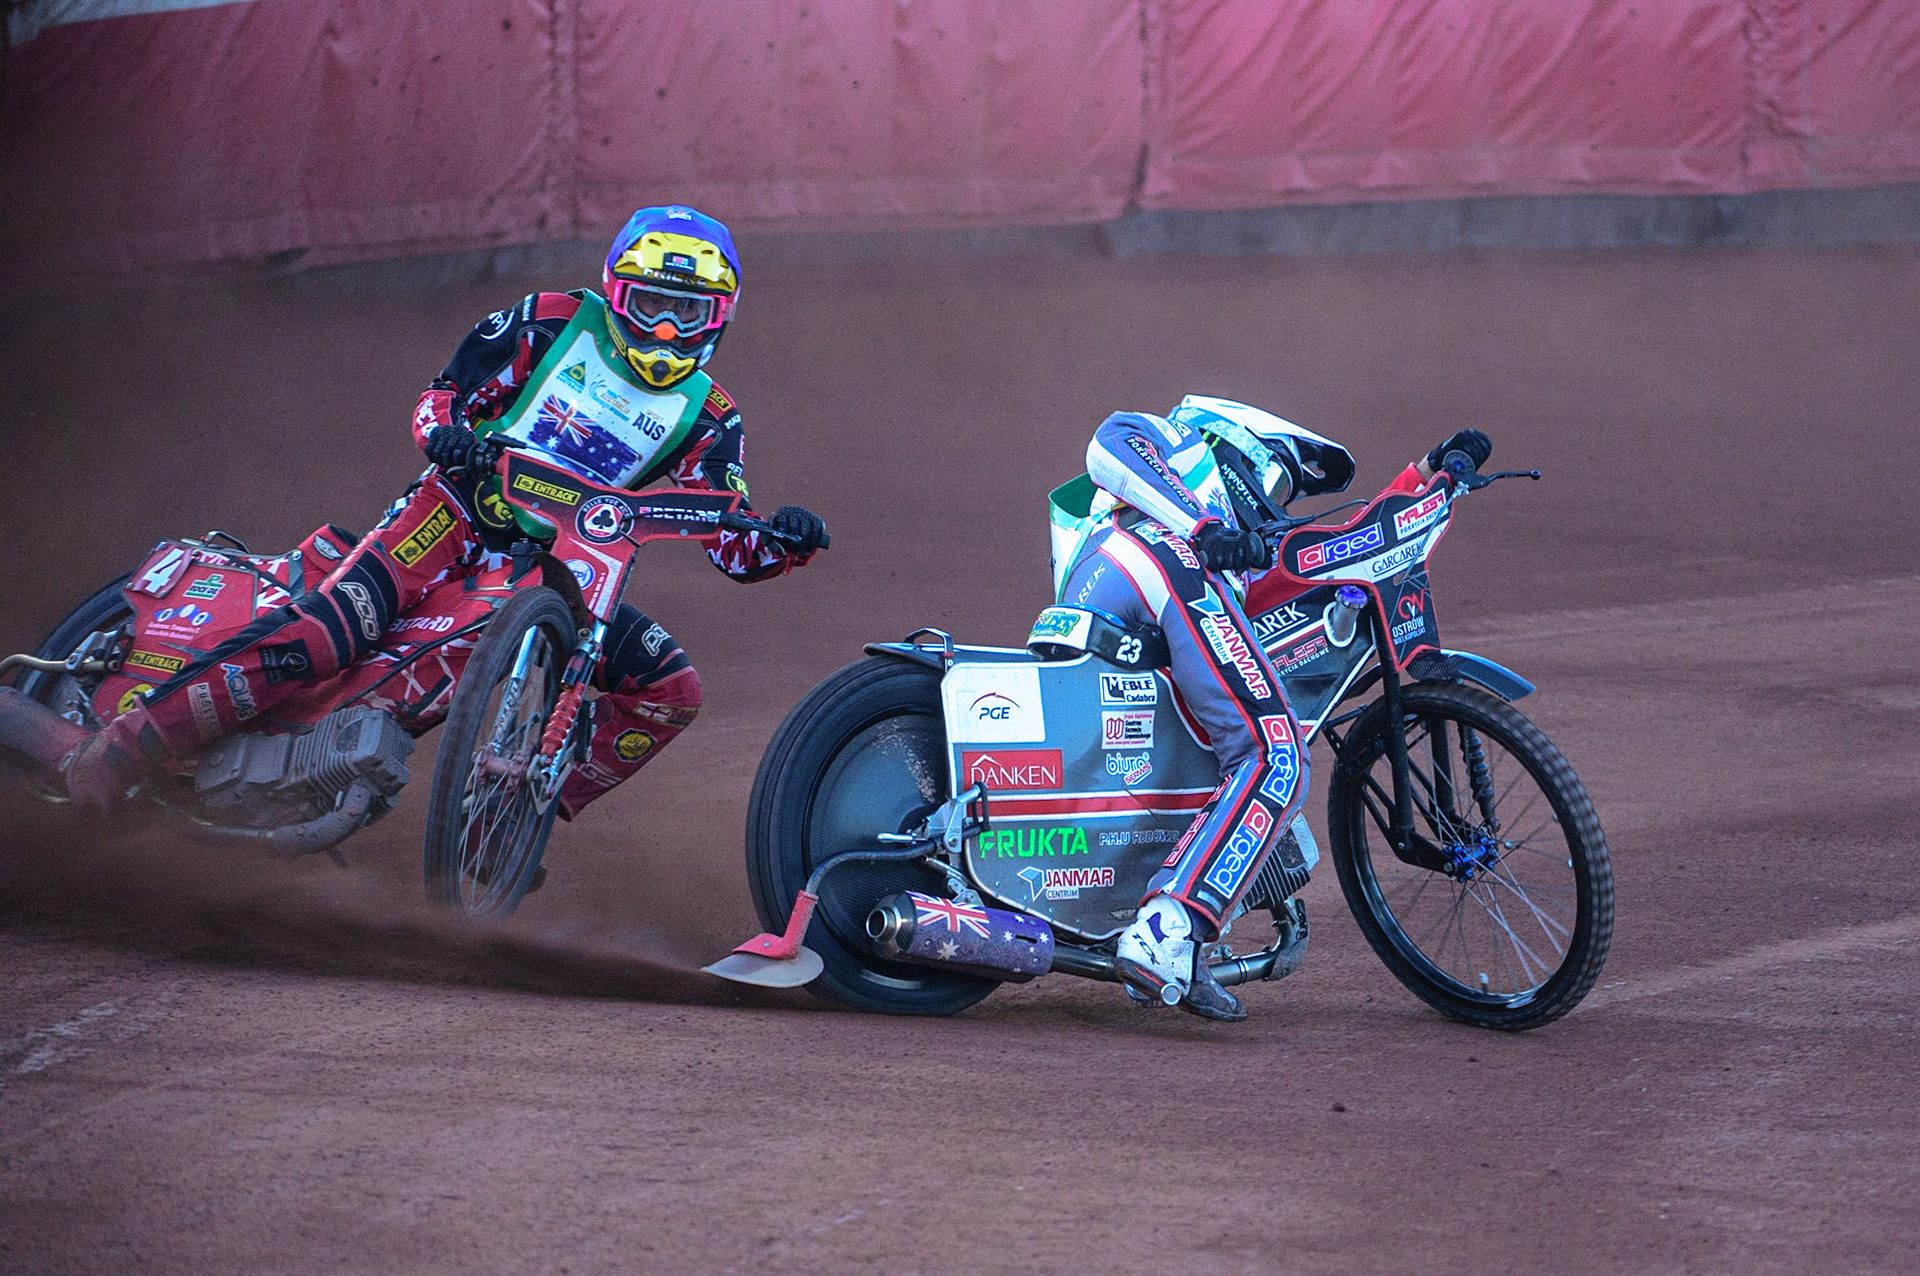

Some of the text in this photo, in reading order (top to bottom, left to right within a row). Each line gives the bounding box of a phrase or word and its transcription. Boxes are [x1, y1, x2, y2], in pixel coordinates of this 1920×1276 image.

[707, 391, 726, 408] ACK
[632, 411, 665, 440] AUS
[1127, 438, 1163, 474] POKRYCIA
[1163, 475, 1199, 511] DACHOW
[533, 483, 575, 502] ENTRACK
[583, 498, 602, 512] BELLE
[1304, 524, 1380, 564] arged
[142, 548, 185, 593] 4
[389, 616, 455, 632] BETARD
[1116, 635, 1142, 664] 23
[1202, 619, 1230, 662] CENTRUM
[144, 655, 181, 670] ENTRACK
[1212, 616, 1269, 697] JANMAR
[1299, 647, 1330, 667] DACHOWE
[1109, 677, 1155, 691] MEBLE
[1126, 694, 1156, 703] Cadabra
[979, 707, 1011, 720] PGE
[1106, 752, 1147, 775] biuro
[1125, 763, 1151, 783] SERWIS
[971, 765, 1057, 786] DANKEN
[978, 827, 1089, 859] FRUKTA
[1213, 812, 1267, 895] arged
[1046, 869, 1114, 887] JANMAR
[1046, 889, 1079, 899] CENTRUM
